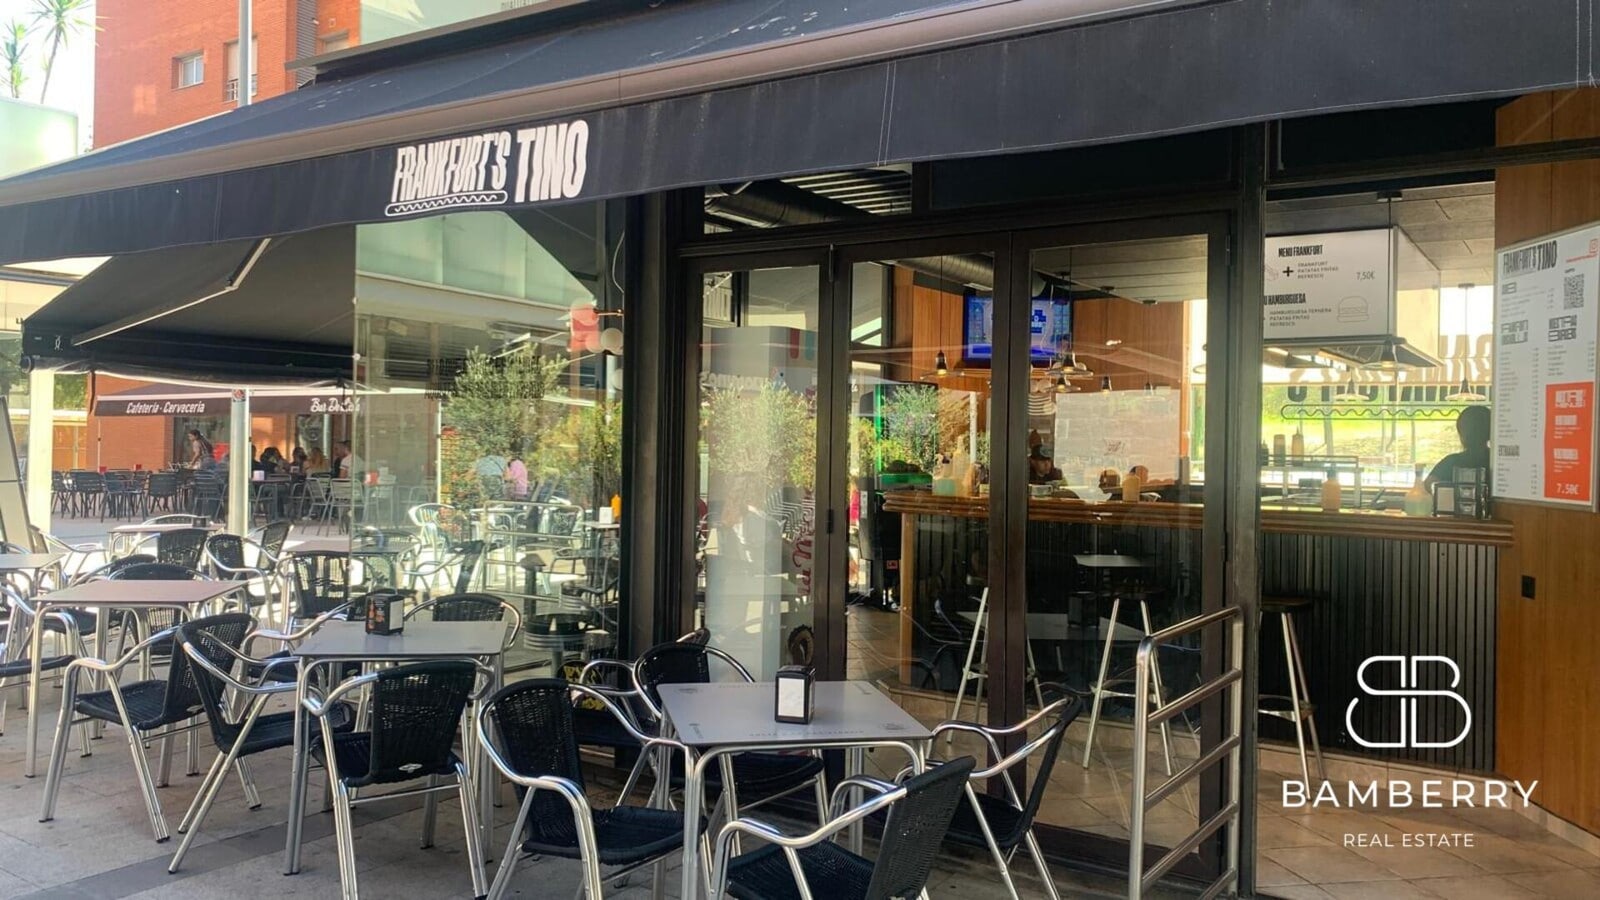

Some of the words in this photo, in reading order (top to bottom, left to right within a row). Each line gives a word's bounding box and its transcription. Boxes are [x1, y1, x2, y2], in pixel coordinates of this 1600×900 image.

[391, 131, 511, 202] FRANKFURT'S
[515, 120, 589, 203] TINO
[1293, 245, 1323, 256] FRANKFURT
[1537, 240, 1558, 271] TINO
